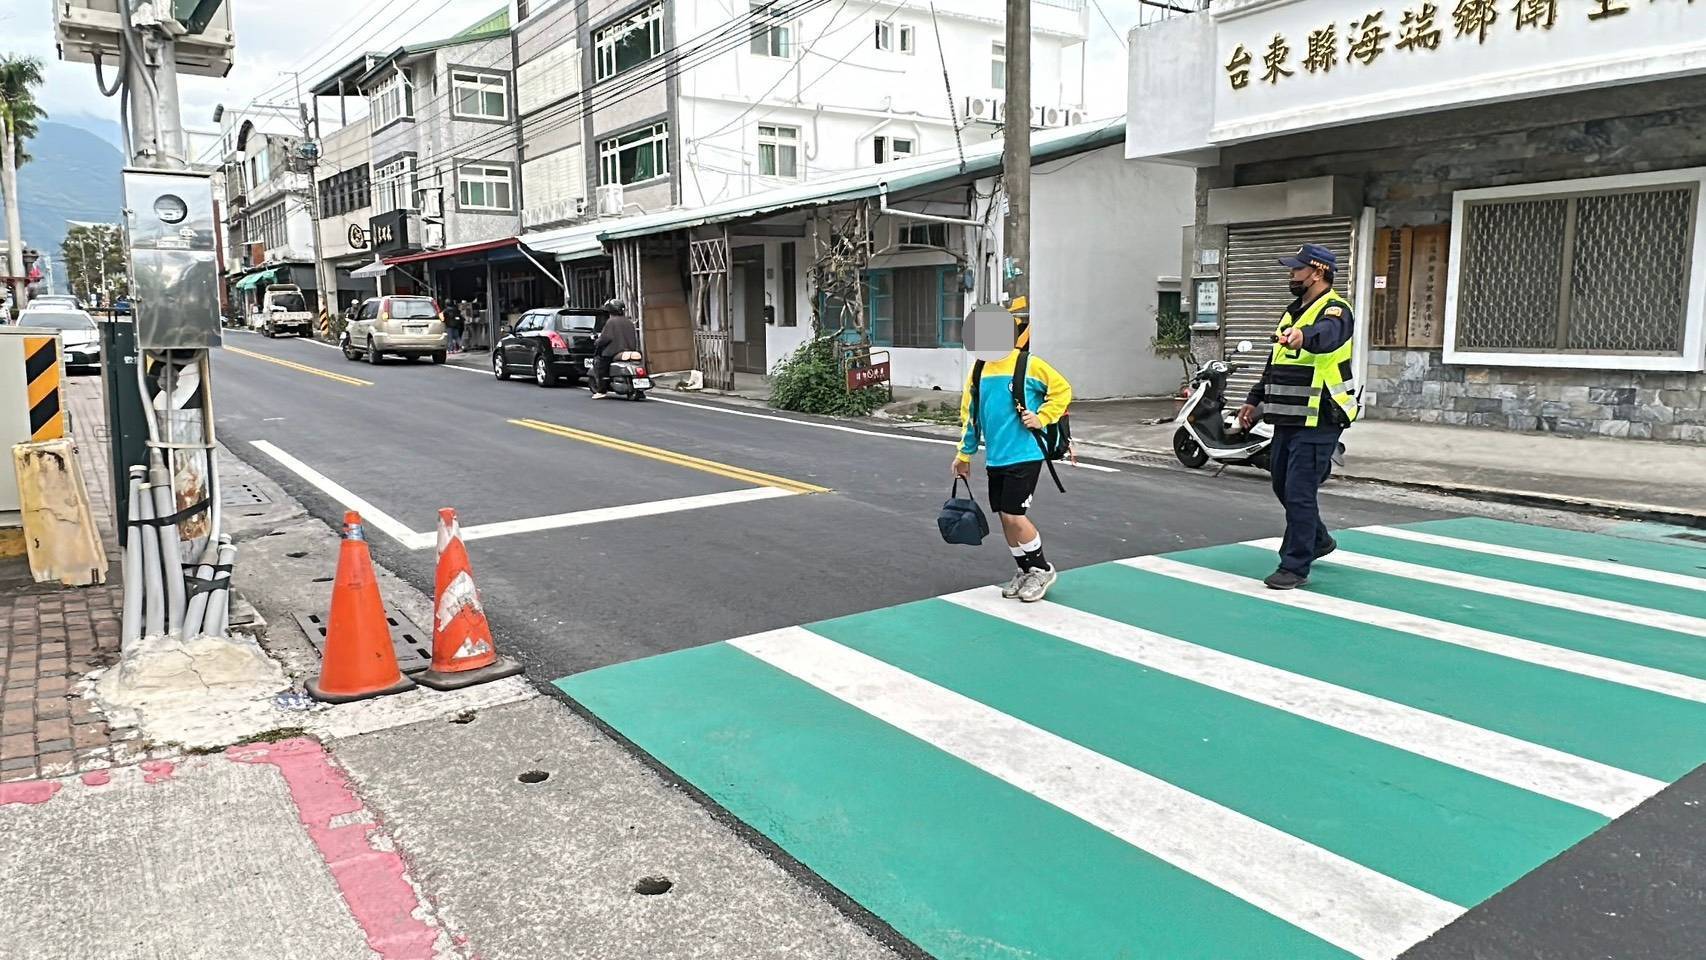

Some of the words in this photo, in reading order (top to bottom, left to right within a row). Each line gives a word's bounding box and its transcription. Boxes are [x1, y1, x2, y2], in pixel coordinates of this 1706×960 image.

[1224, 0, 1696, 90] 台東縣海端鄉衛
